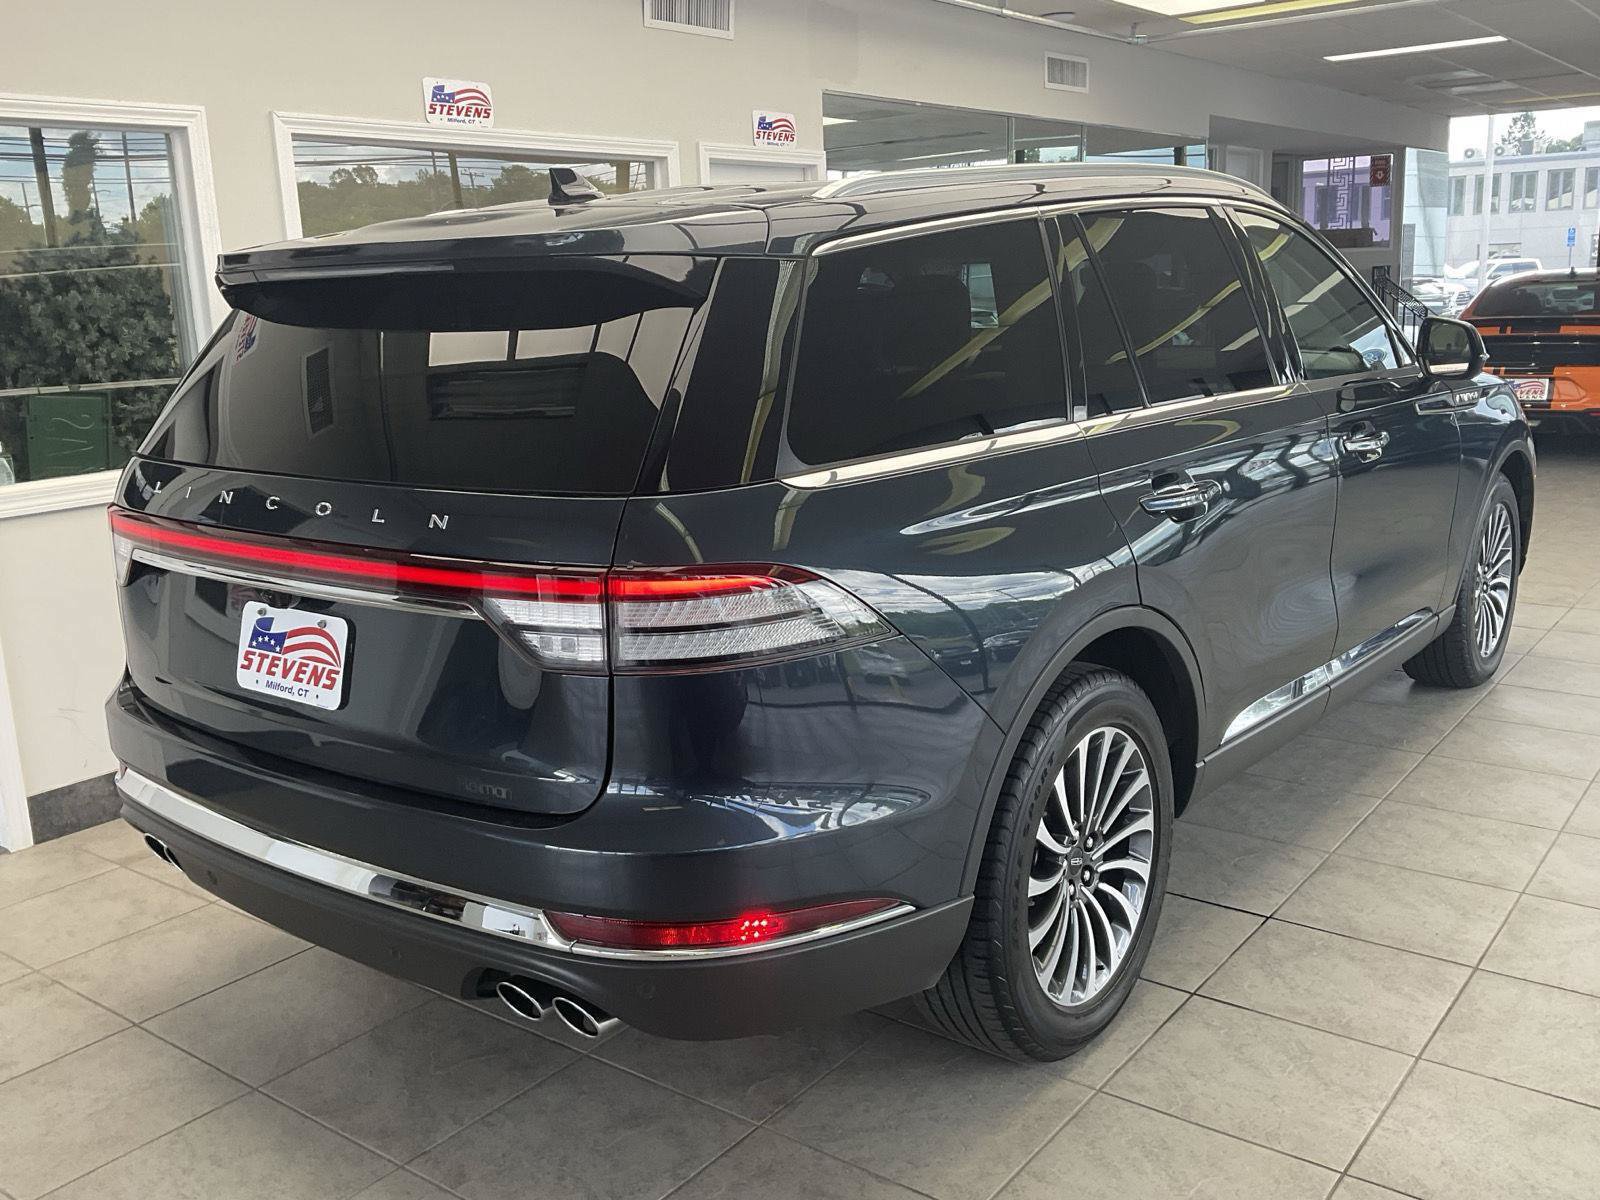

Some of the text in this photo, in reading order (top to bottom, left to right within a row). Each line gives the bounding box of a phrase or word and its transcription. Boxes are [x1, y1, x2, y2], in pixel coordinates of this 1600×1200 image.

[428, 103, 492, 119] STEVENS
[755, 130, 795, 142] STEVENS
[153, 481, 449, 530] LINCOLN
[240, 650, 341, 691] STEVENS
[265, 679, 310, 698] Milford, CT
